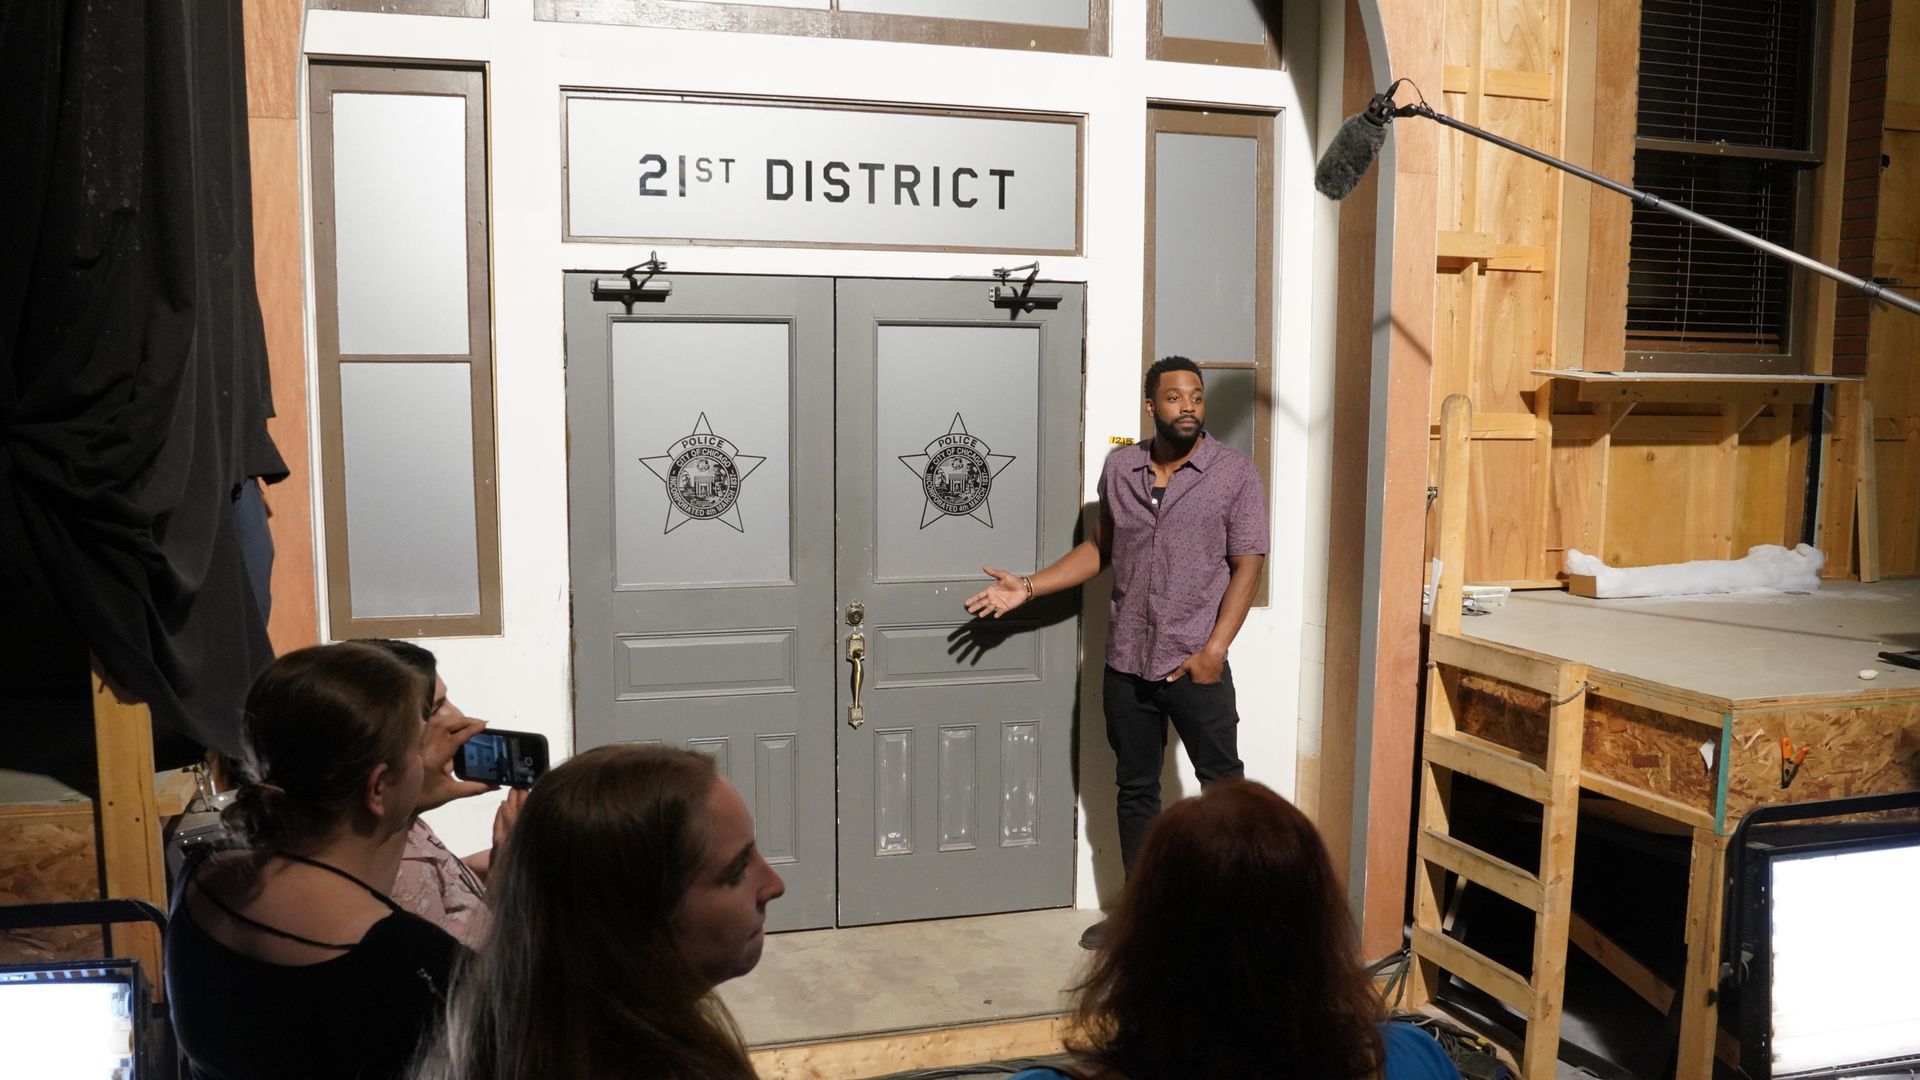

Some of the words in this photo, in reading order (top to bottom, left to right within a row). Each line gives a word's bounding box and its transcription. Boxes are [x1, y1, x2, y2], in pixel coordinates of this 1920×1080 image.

[638, 153, 735, 198] 21ST
[766, 158, 1015, 210] DISTRICT
[682, 437, 725, 448] POLICE
[938, 436, 978, 447] POLICE
[676, 452, 691, 467] CITY
[691, 449, 701, 457] OF
[702, 449, 731, 468] CHICAGO
[933, 451, 946, 465] CITY
[946, 448, 956, 456] OF
[957, 448, 984, 466] CHICAGO
[669, 475, 705, 516] INCORPORATED
[717, 490, 736, 512] MARCH
[925, 473, 958, 512] INCORPORATED
[958, 504, 969, 512] 4th
[969, 487, 986, 508] MARCH
